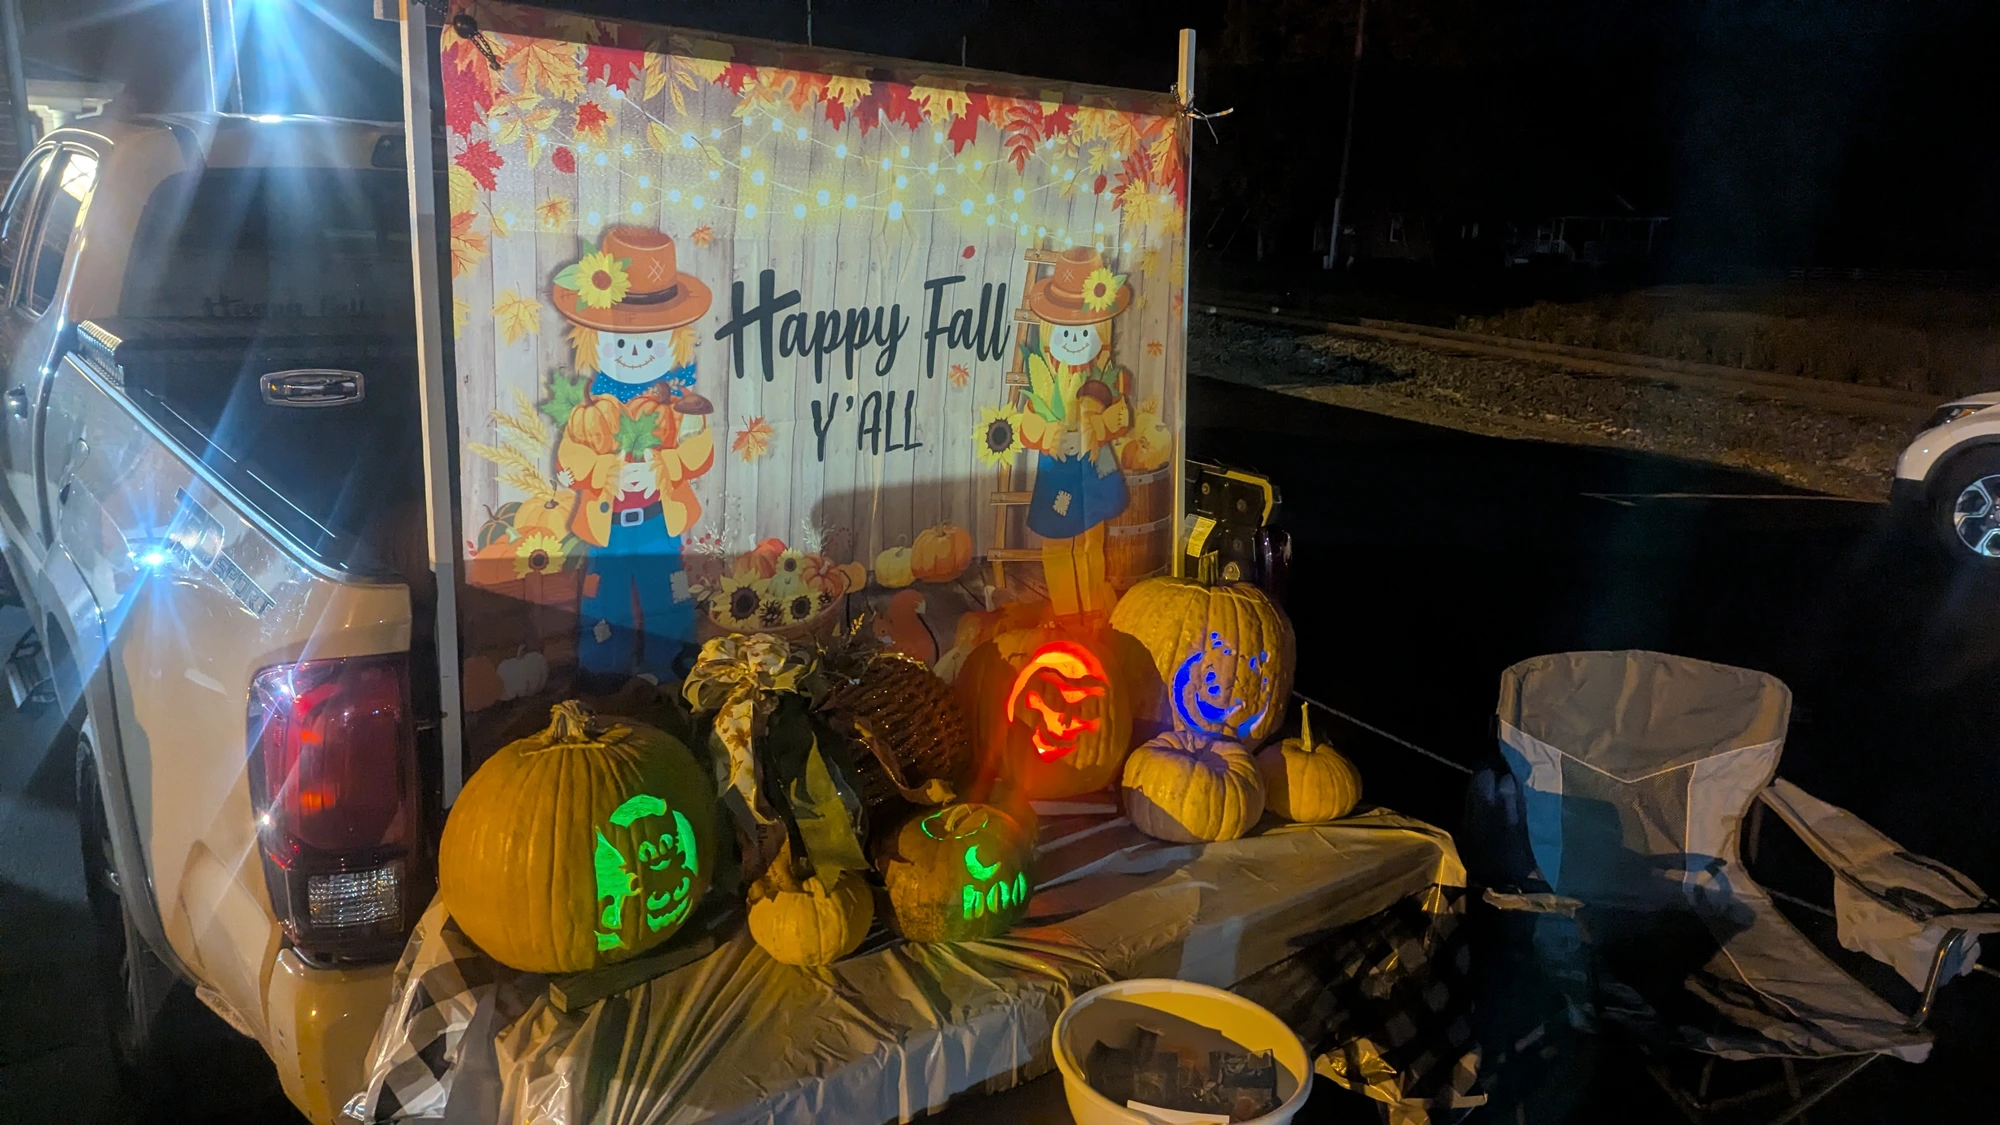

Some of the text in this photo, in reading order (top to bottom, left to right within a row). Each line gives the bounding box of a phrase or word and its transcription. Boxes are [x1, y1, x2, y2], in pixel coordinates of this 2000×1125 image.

[714, 268, 1012, 384] Happy Fall
[810, 389, 924, 462] Y'ALL
[211, 554, 277, 617] SPORT
